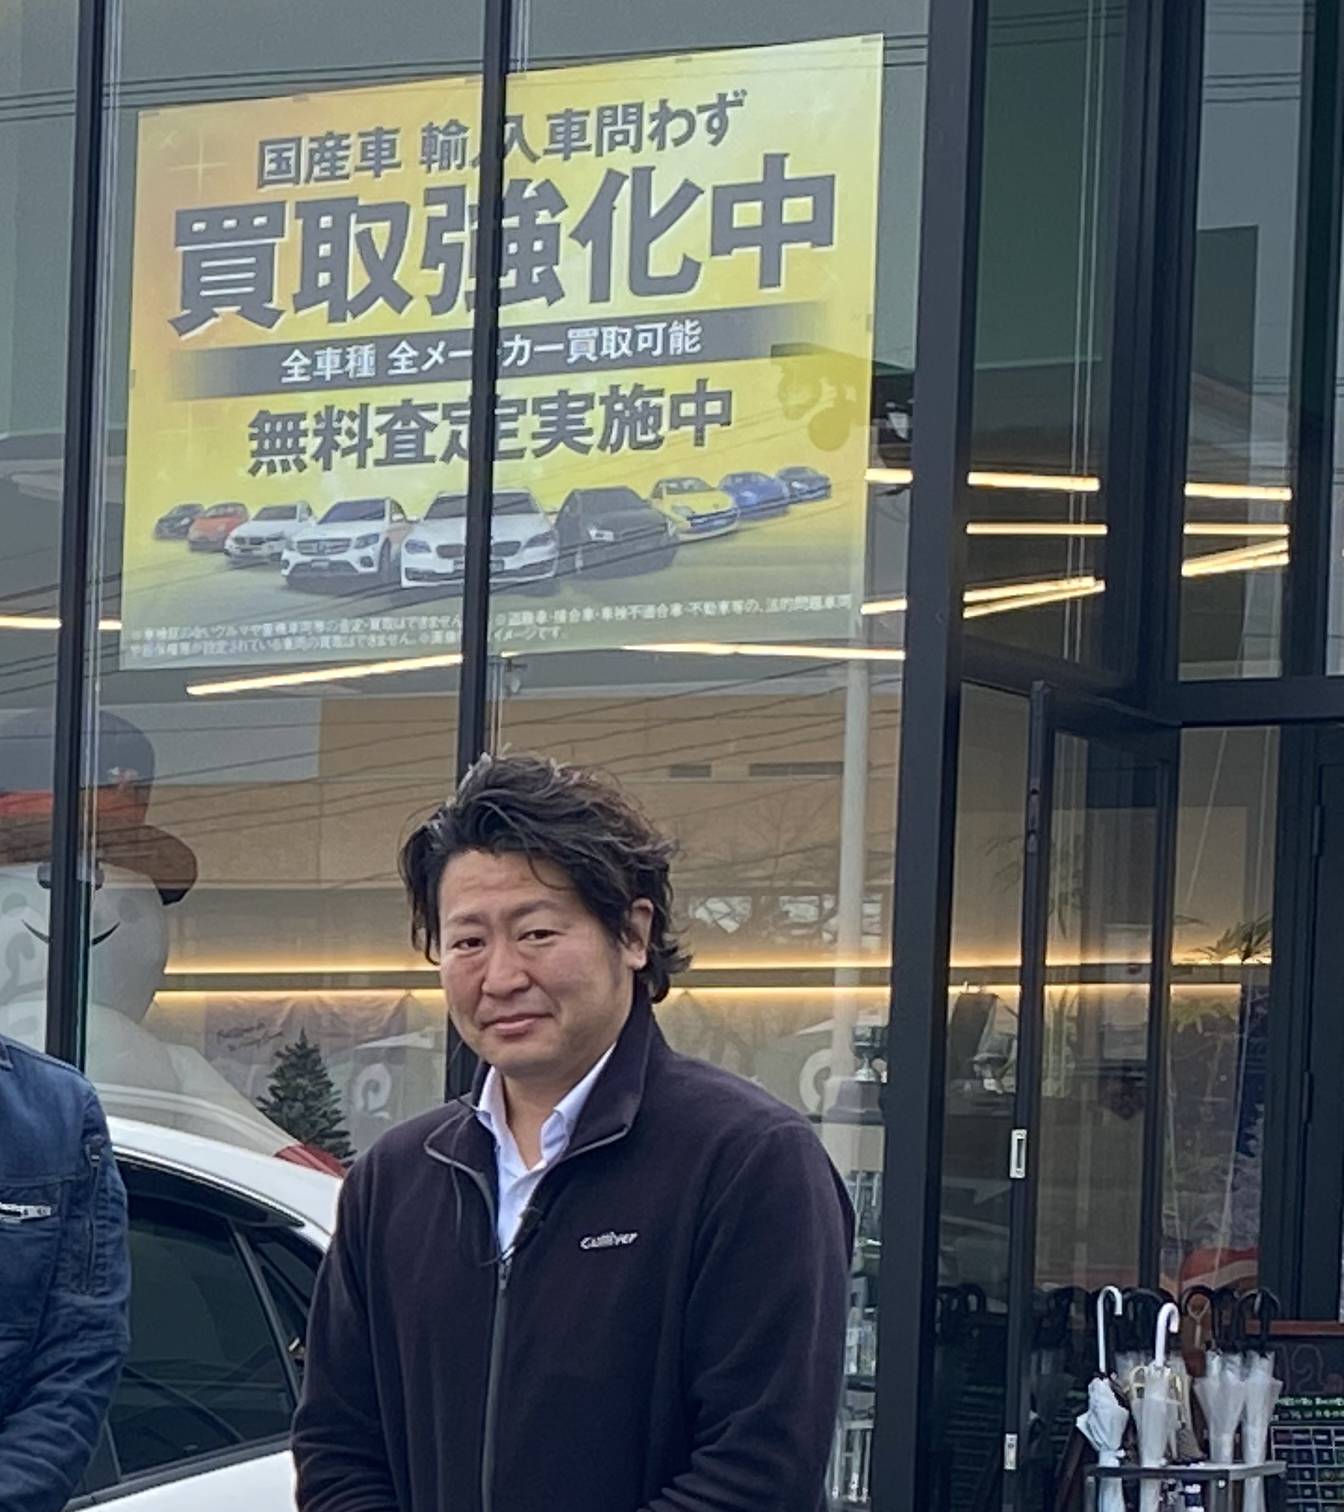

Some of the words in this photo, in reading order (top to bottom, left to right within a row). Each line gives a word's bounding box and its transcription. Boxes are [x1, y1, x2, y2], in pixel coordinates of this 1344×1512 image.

[257, 126, 401, 190] 国産車
[420, 89, 748, 171] 輸入車問わず
[167, 153, 837, 337] 買取強化中
[280, 342, 377, 384] 全車種
[388, 319, 703, 375] 全メーカー買取可能
[247, 377, 733, 477] 無料査定実施中
